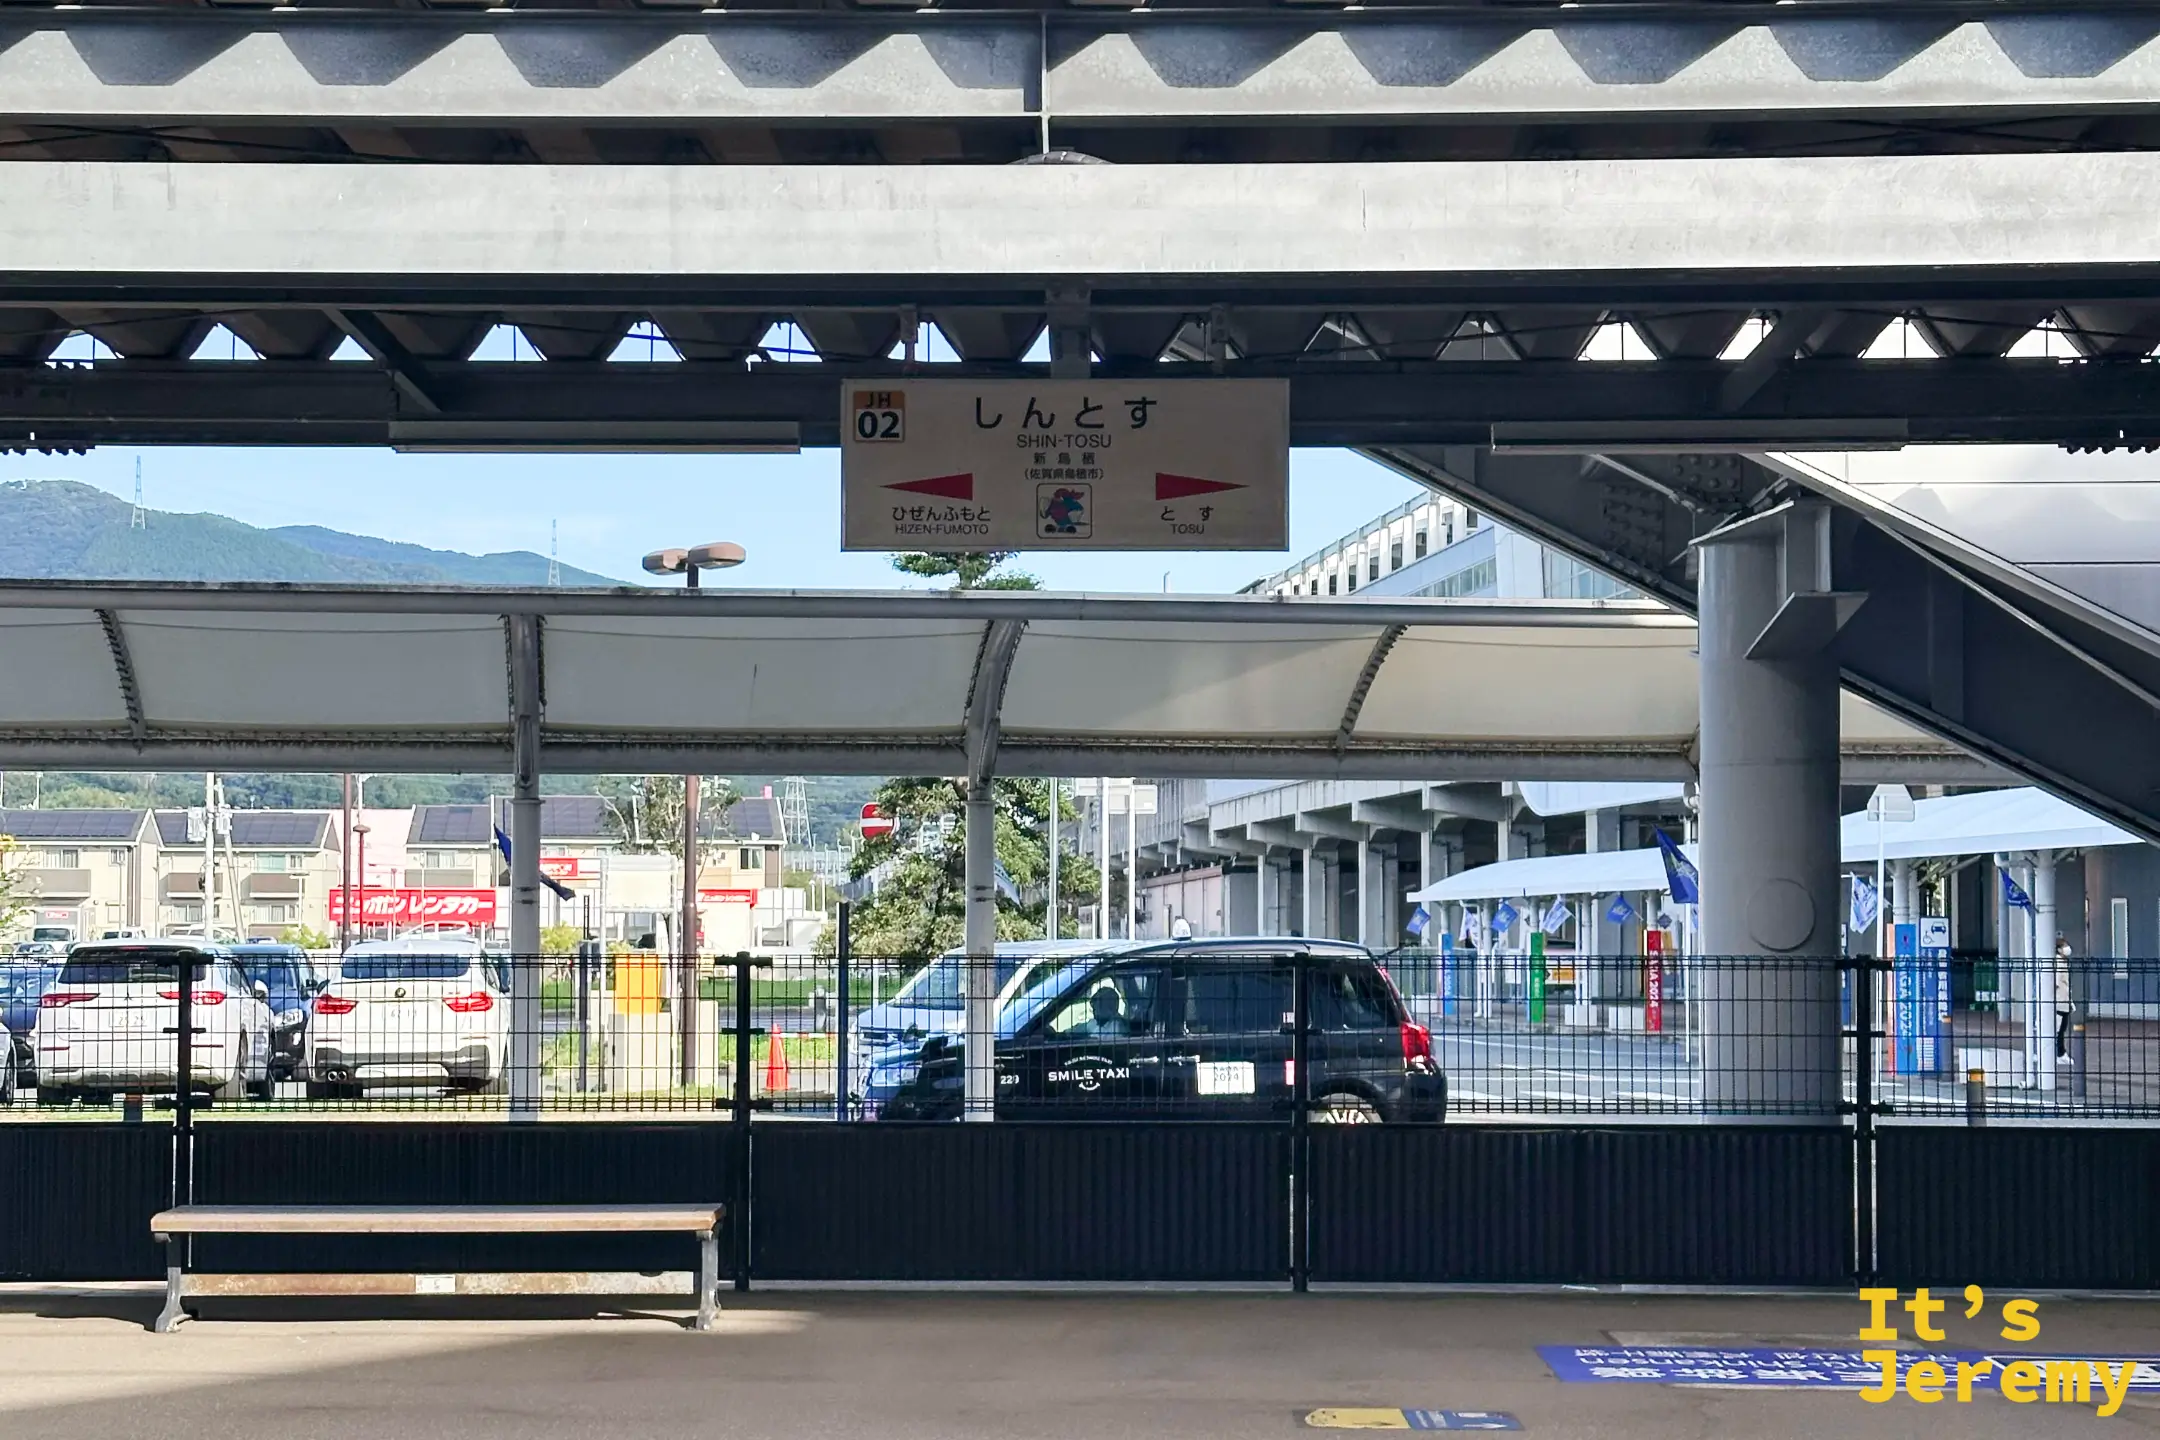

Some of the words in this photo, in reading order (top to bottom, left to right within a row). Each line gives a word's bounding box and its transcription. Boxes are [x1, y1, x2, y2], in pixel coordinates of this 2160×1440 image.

[866, 391, 892, 408] JH
[975, 396, 1158, 429] しんとす
[858, 411, 900, 439] 02
[1016, 434, 1112, 449] SHIN-TOSU
[1033, 451, 1096, 466] 新鳥栖
[892, 505, 991, 521] ひぜんふもと
[1160, 505, 1214, 522] とす
[895, 523, 989, 535] HIZEN-FUMOTO
[1171, 523, 1205, 535] TOSU
[1048, 1069, 1094, 1081] SMILE
[1096, 1067, 1130, 1079] TAXI
